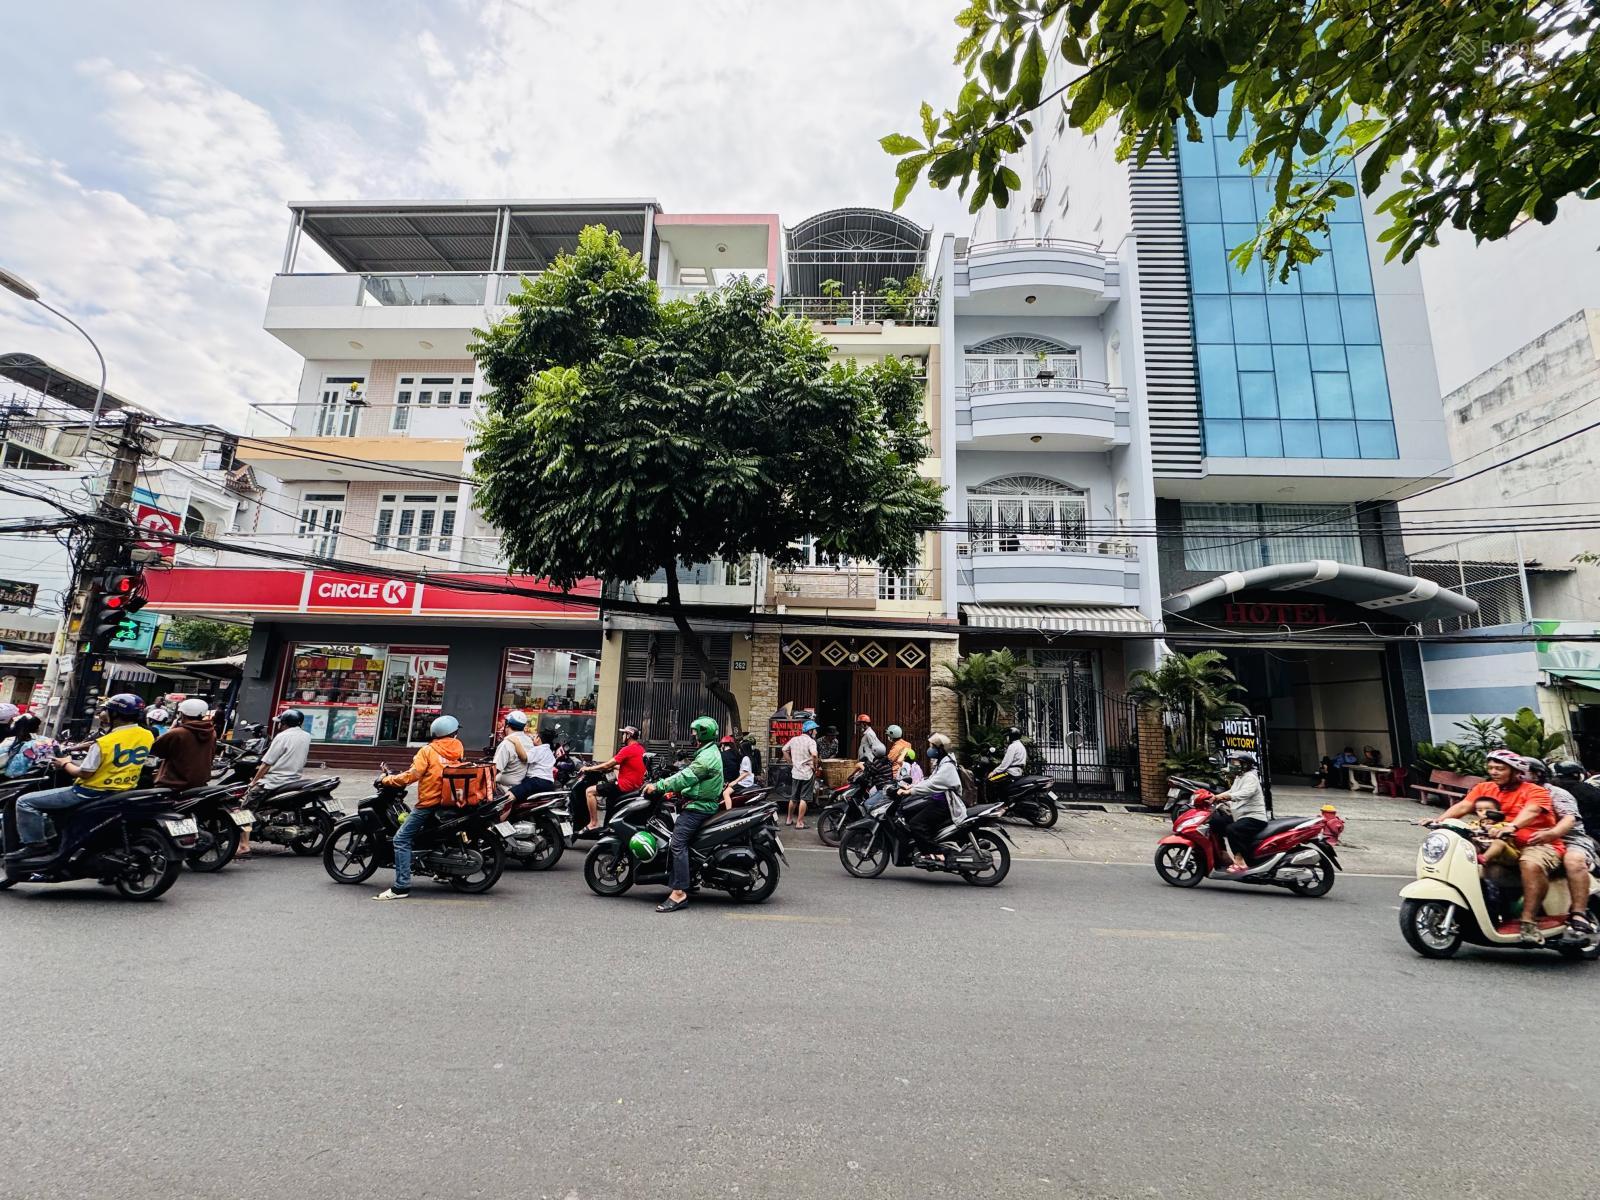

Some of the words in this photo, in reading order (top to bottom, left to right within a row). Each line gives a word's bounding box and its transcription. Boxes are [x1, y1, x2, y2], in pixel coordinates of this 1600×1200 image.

[318, 582, 379, 599] CIRCLE
[382, 580, 406, 604] K
[1225, 604, 1338, 624] HOTEL
[1224, 720, 1255, 736] HOTEL
[1225, 736, 1255, 749] VICTORY
[113, 743, 149, 768] be
